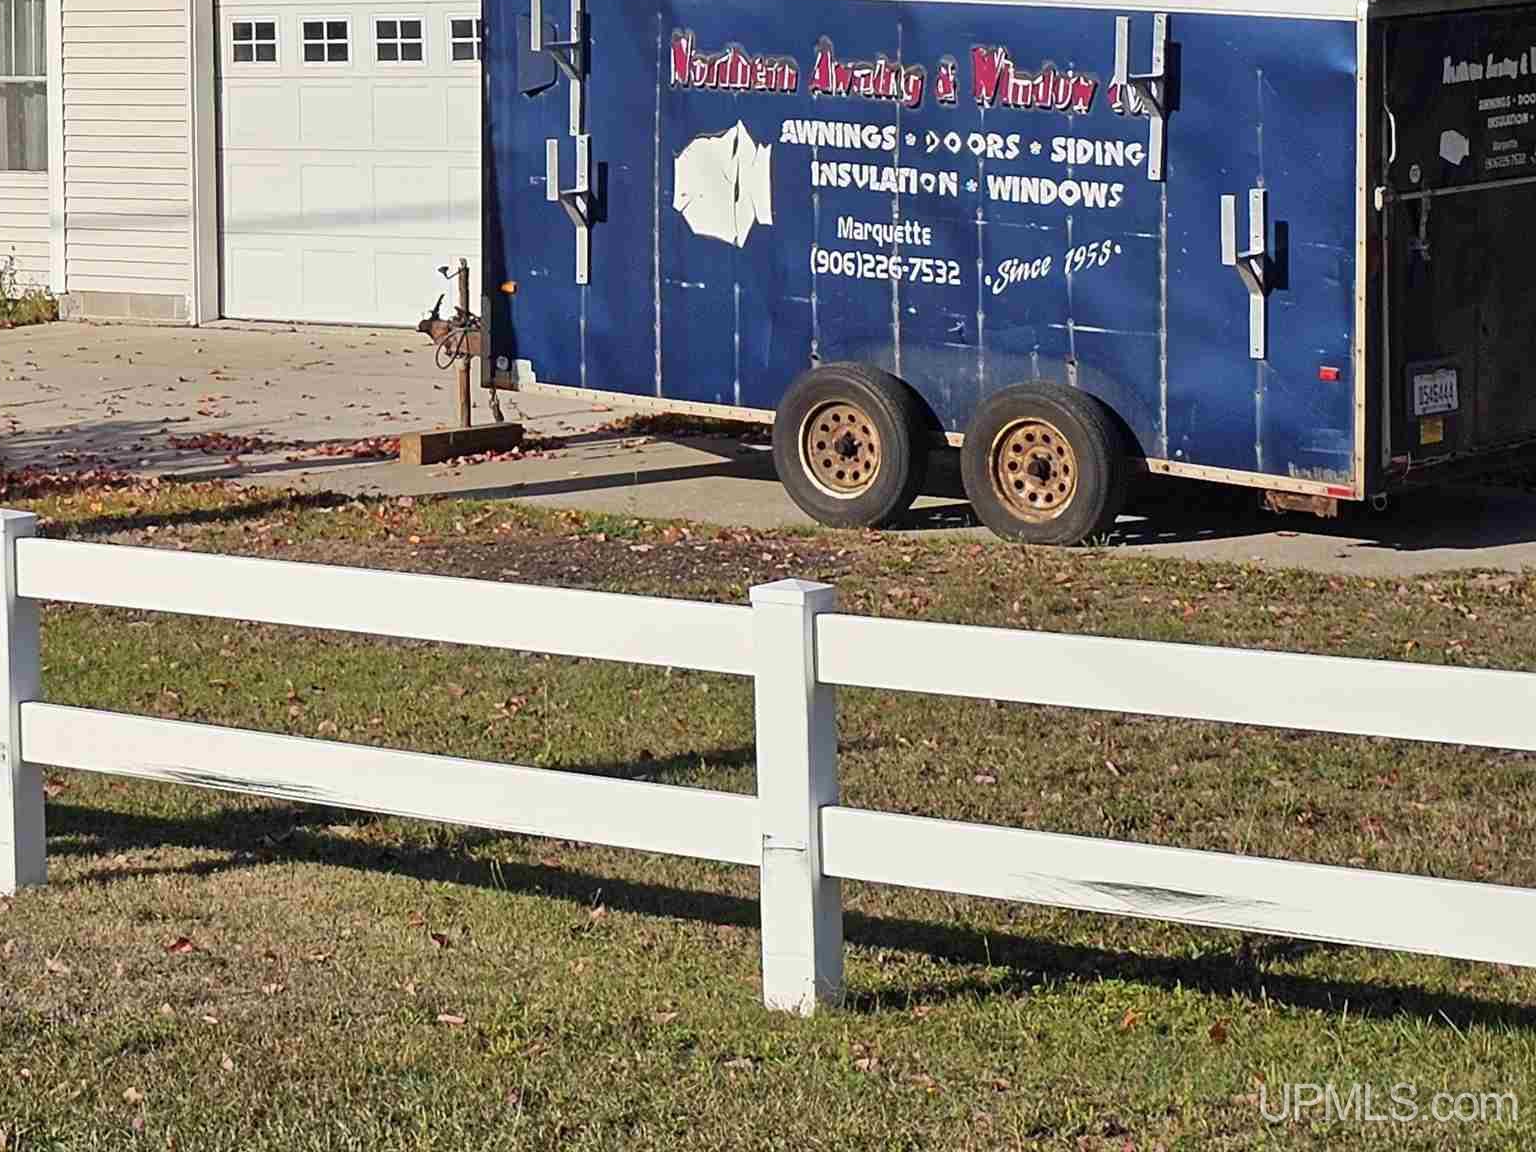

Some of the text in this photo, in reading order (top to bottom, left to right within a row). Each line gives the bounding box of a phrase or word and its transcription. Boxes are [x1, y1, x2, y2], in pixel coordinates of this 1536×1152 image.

[670, 31, 798, 95] Northern
[808, 37, 925, 109] Awning
[971, 46, 1098, 115] Window
[779, 119, 898, 151] AWNINGS
[1050, 136, 1147, 167] SIDING
[811, 161, 1124, 209] INSULATION WINDOWS
[837, 216, 932, 247] Marquette
[810, 248, 961, 286] (906)226-7532
[992, 255, 1052, 295] Since
